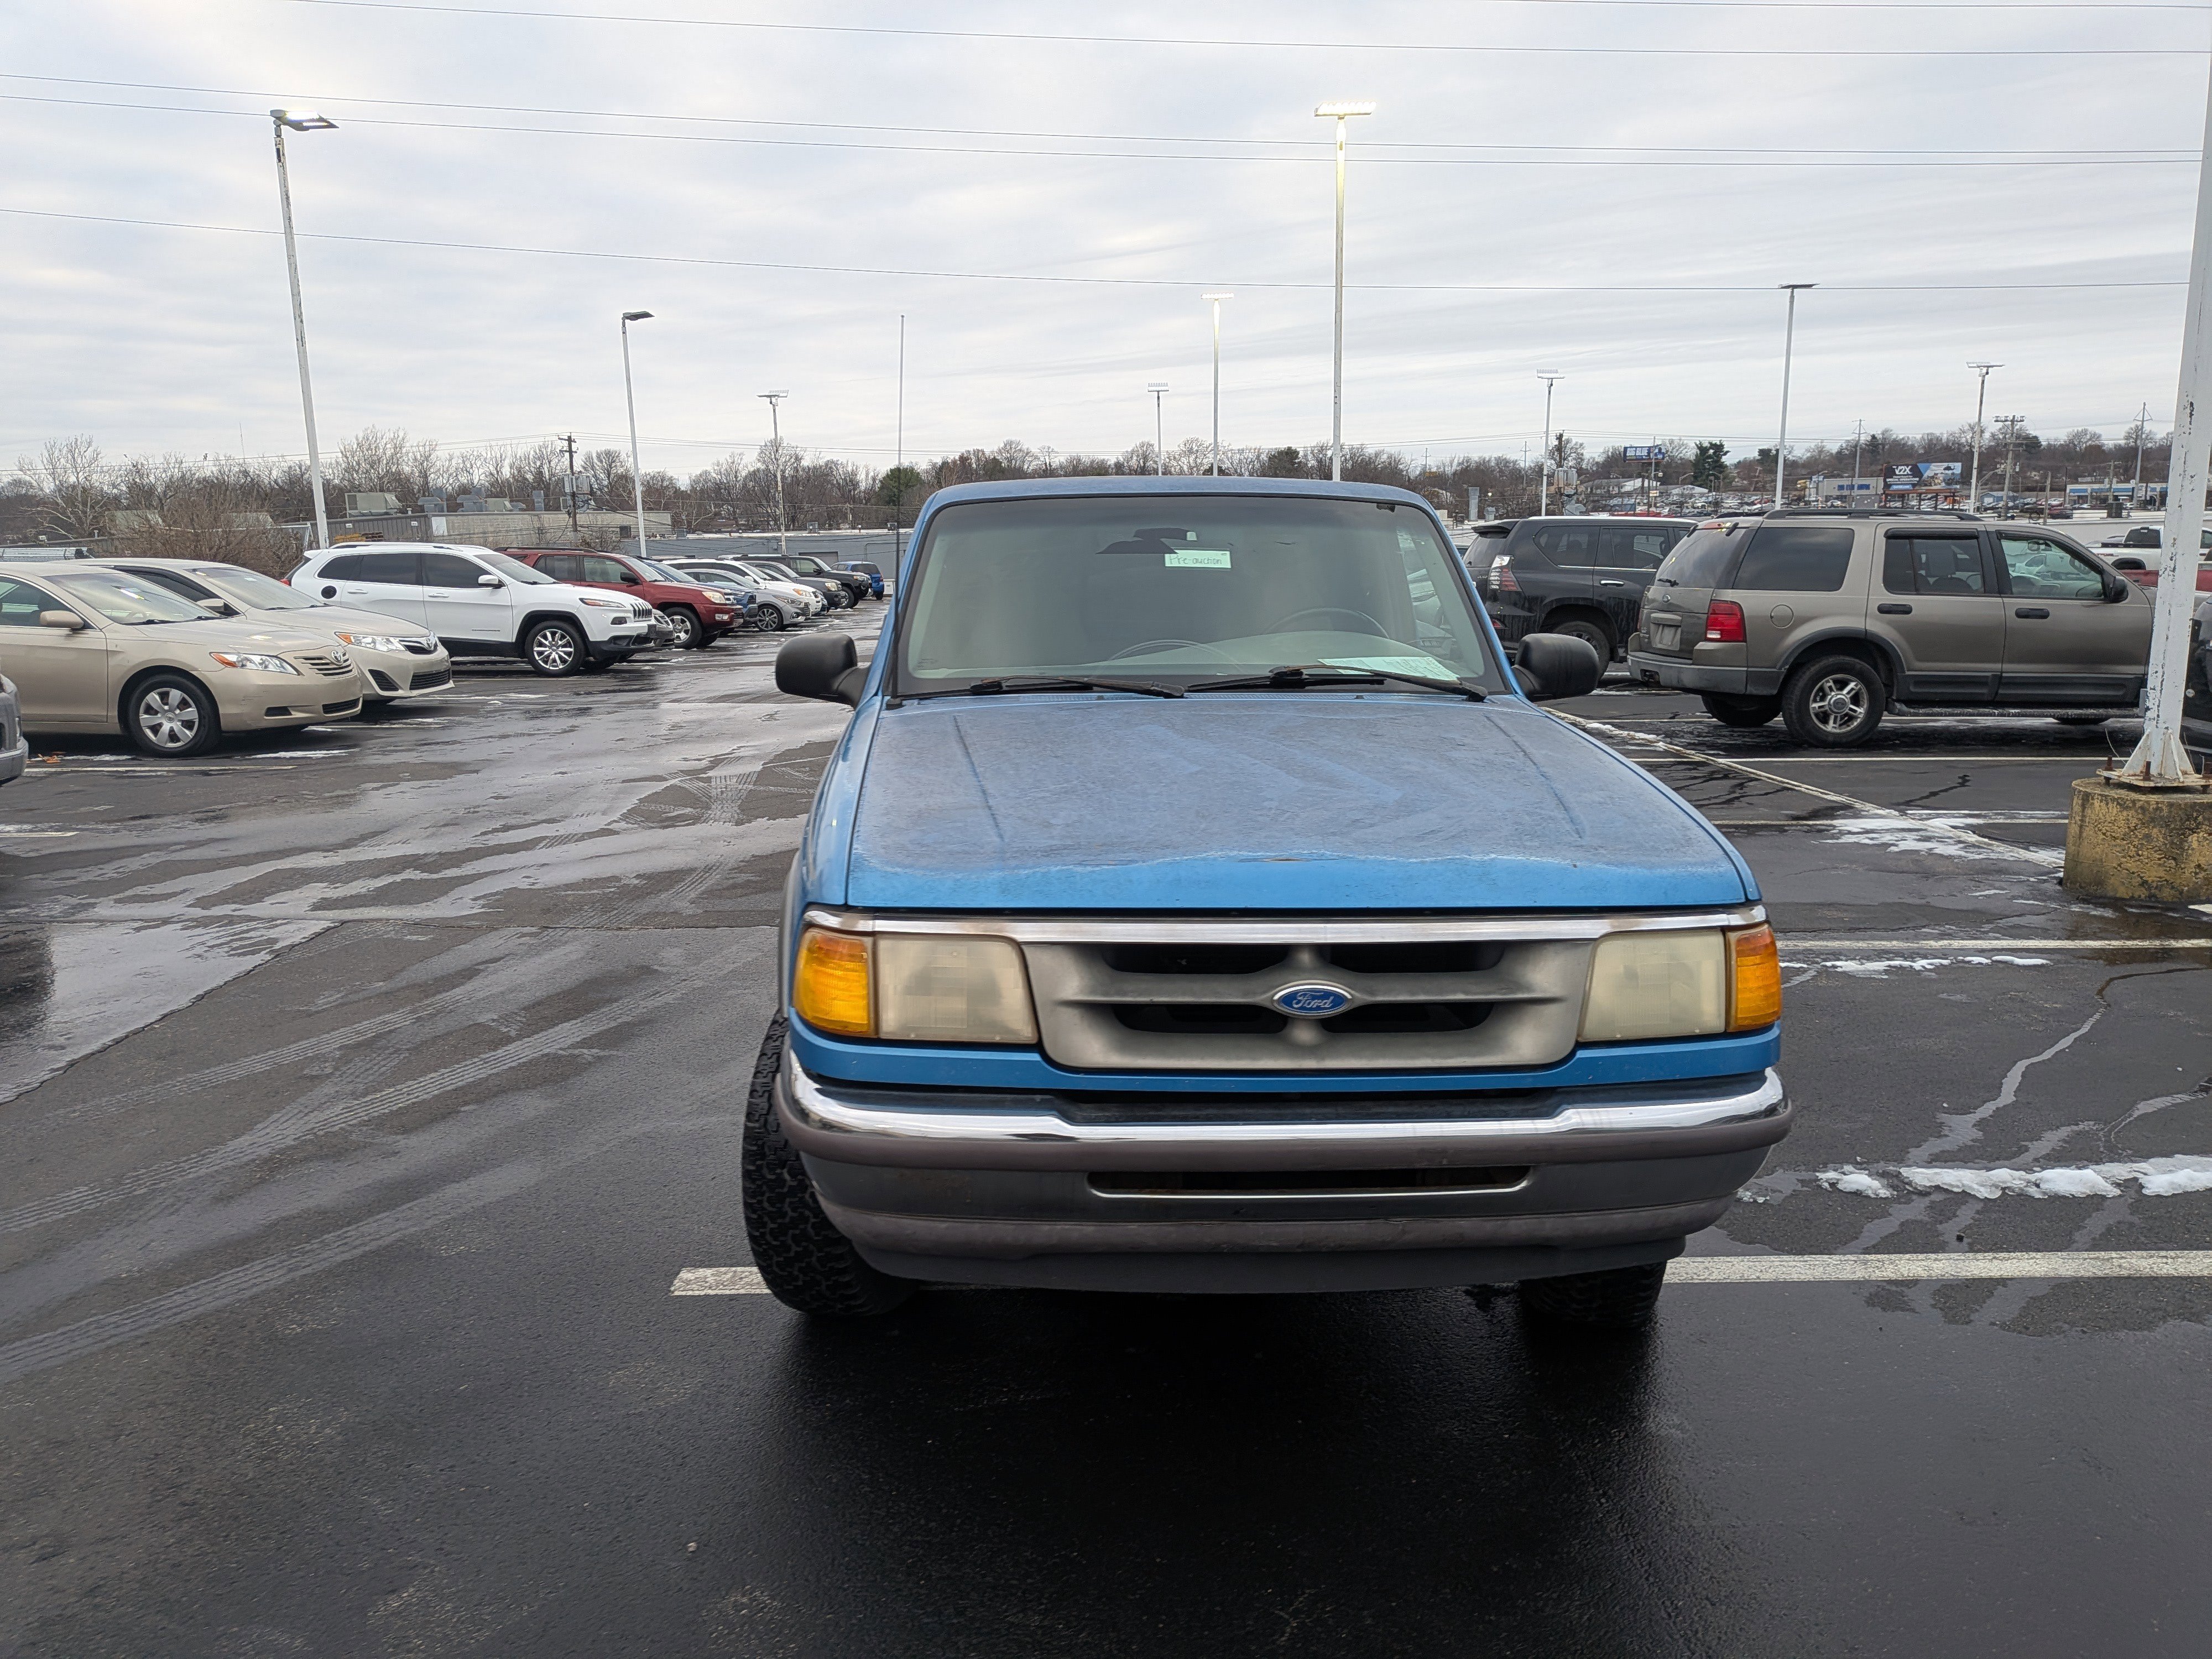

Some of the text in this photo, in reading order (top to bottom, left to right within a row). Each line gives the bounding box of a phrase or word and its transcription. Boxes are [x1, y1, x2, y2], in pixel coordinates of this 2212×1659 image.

[1892, 466, 1912, 474] V2X
[1169, 554, 1222, 565] Pre-auction
[1292, 992, 1334, 1008] Ford
